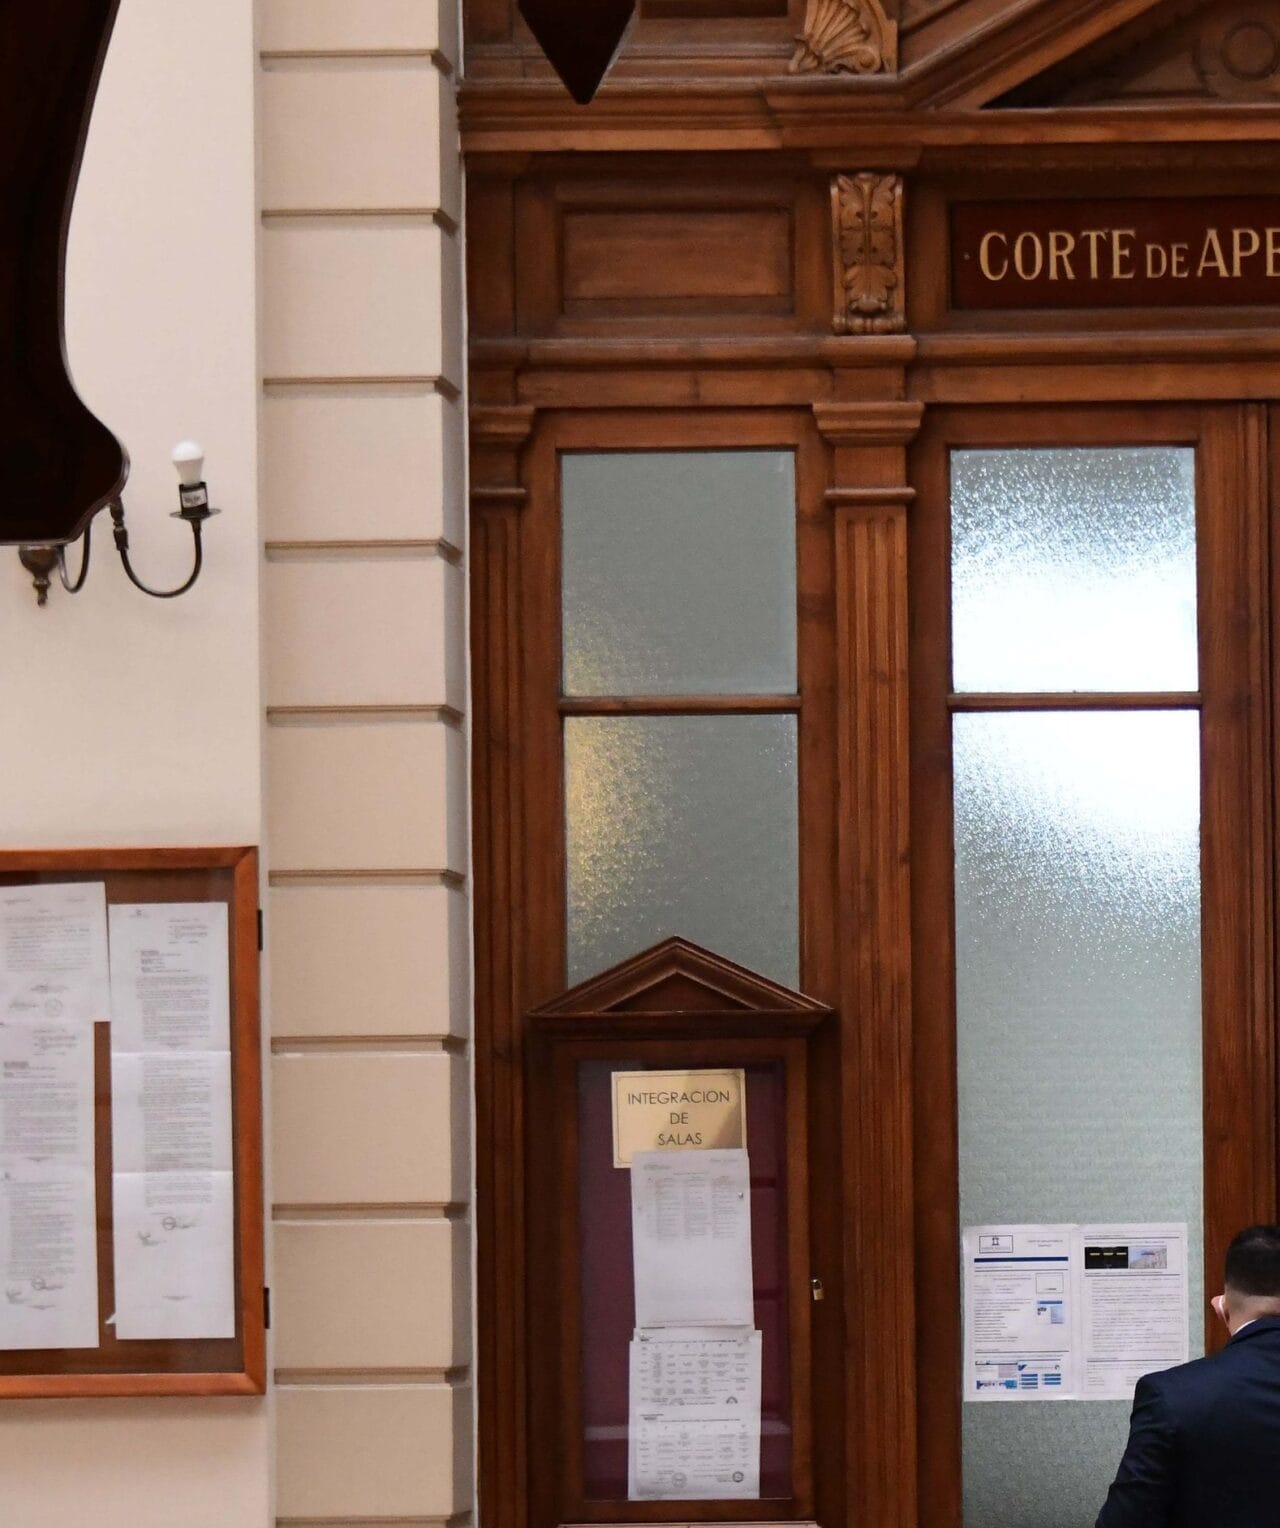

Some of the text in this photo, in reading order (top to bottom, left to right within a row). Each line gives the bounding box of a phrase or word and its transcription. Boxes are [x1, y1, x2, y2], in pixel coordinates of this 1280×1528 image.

[979, 229, 1137, 281] CORTE
[1146, 242, 1190, 279] DE
[627, 1089, 731, 1106] INTEGRACION
[669, 1112, 689, 1125] DE
[657, 1132, 703, 1146] SALAS
